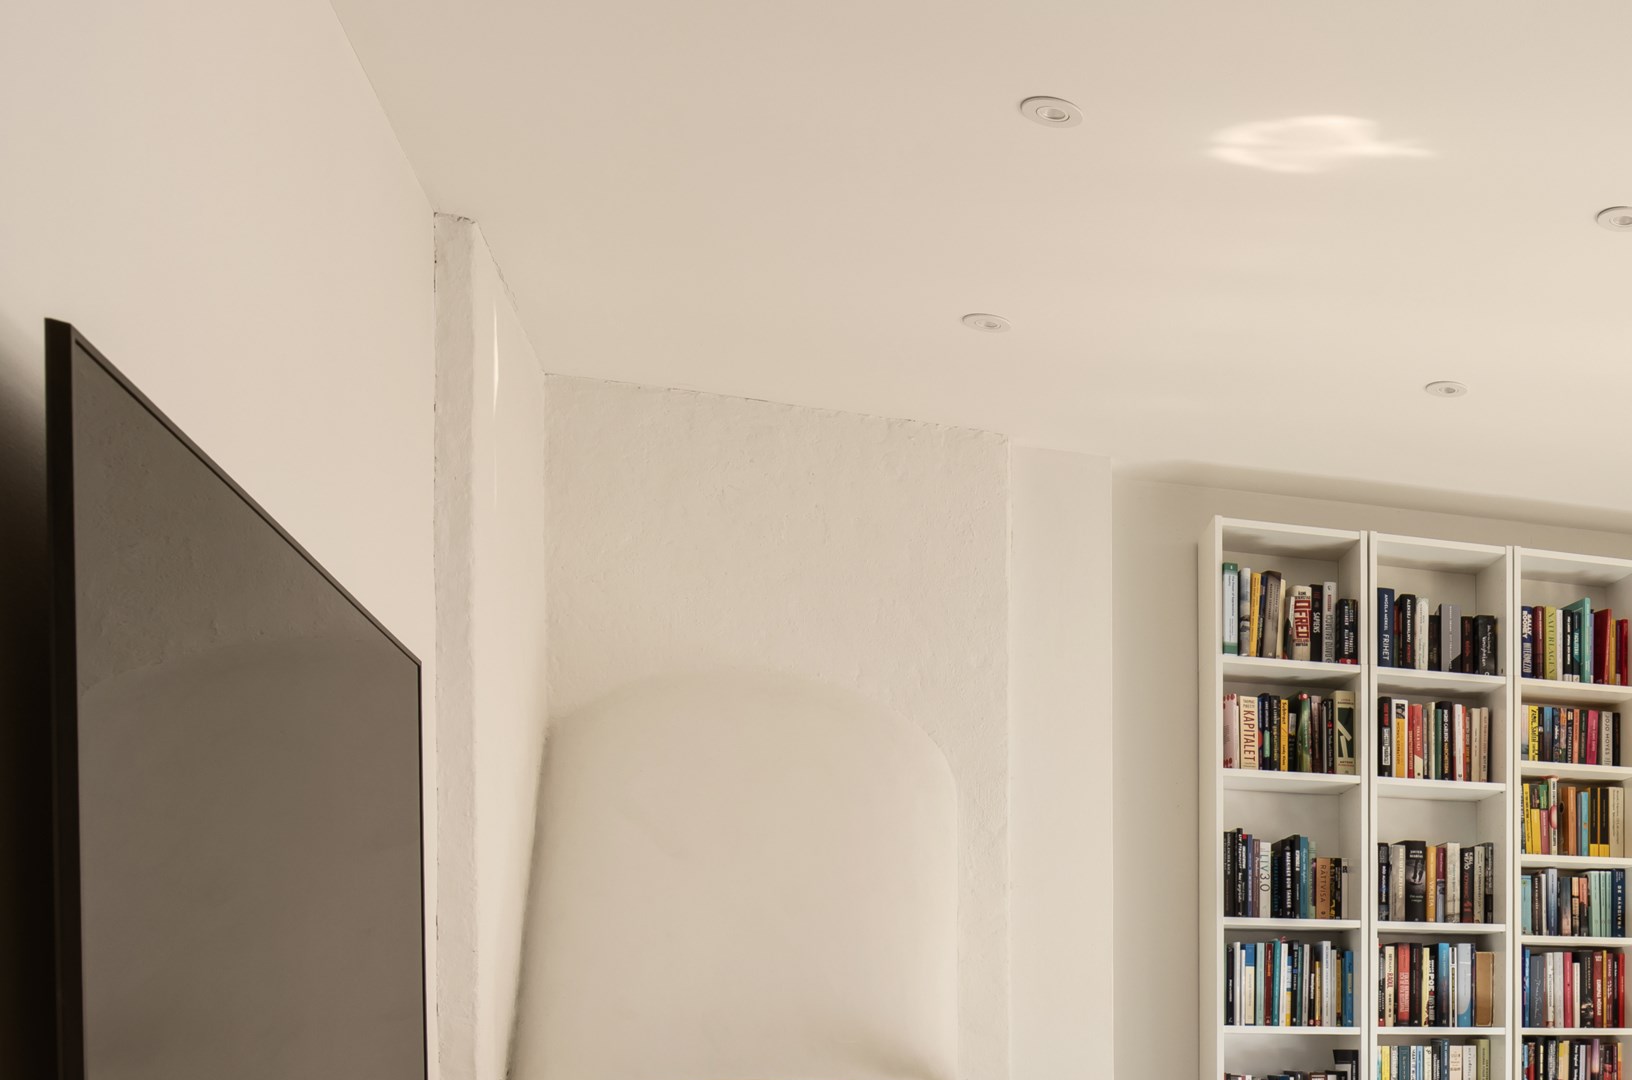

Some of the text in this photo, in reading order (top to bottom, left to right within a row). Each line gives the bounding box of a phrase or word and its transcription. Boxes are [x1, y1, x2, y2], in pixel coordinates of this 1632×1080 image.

[1325, 615, 1333, 640] BALDACCI
[1523, 643, 1532, 673] INTERMEZZO
[1243, 710, 1256, 761] KAPITALET
[1260, 855, 1270, 891] LIV 3.0
[1617, 885, 1621, 893] DE
[1464, 901, 1472, 912] 41
